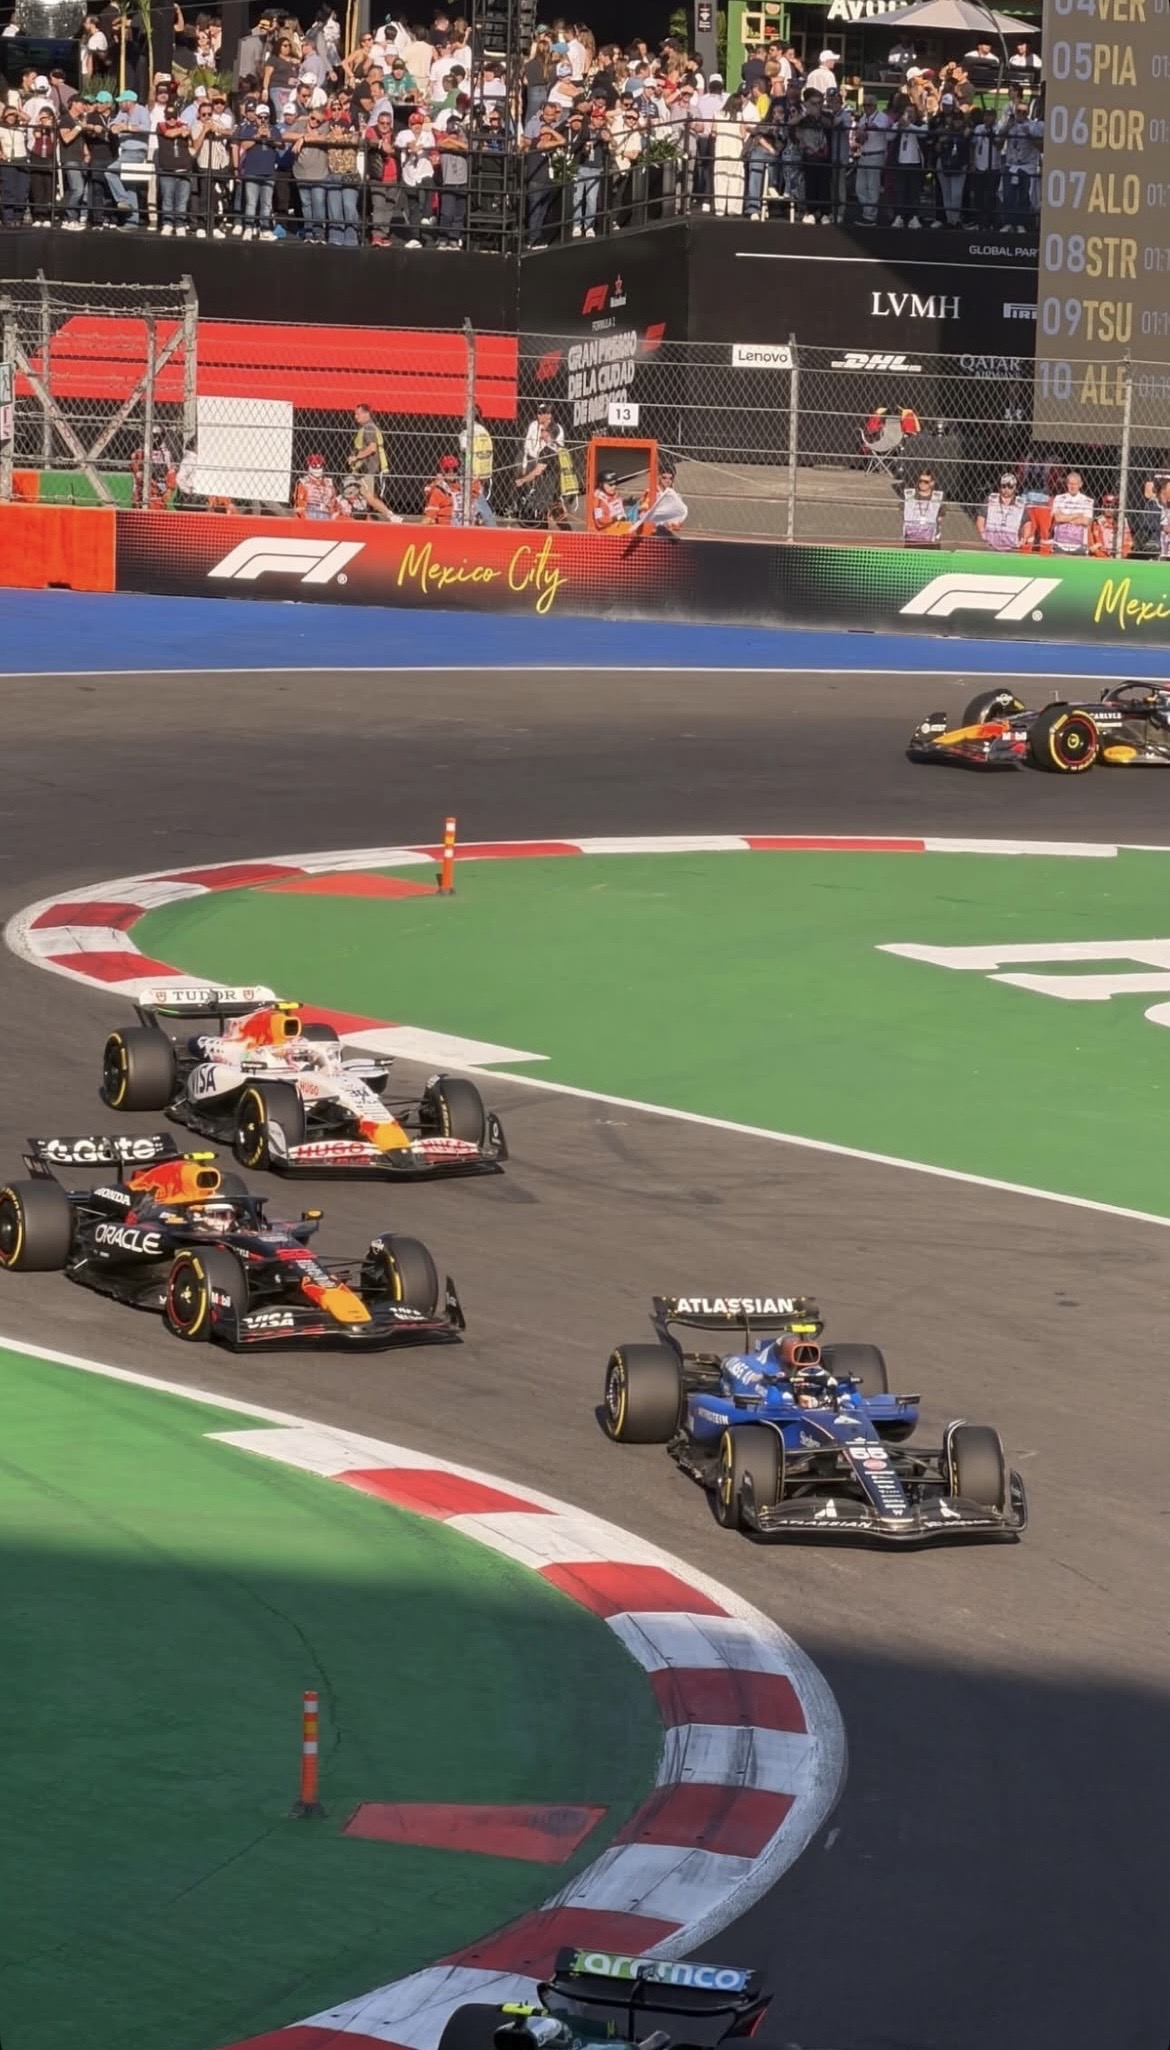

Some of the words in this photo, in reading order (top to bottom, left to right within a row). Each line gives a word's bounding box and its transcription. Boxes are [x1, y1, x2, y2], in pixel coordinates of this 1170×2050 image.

[1052, 41, 1092, 80] 05
[1093, 43, 1137, 86] PIA
[1050, 105, 1088, 144] 06
[1091, 108, 1145, 151] BOR
[1047, 169, 1087, 209] 07
[1087, 172, 1140, 215] ALO
[968, 244, 1013, 257] GLOBAL
[1044, 233, 1085, 273] 08
[1086, 236, 1137, 279] STR
[870, 291, 961, 319] LVMH
[1042, 297, 1081, 336] 09
[1082, 300, 1133, 343] TSU
[567, 340, 598, 371] GRAN
[738, 349, 789, 363] Lenovo
[836, 352, 916, 372] DHL
[960, 354, 1021, 372] QATAR
[568, 373, 583, 400] DE
[583, 369, 597, 396] LA
[1040, 361, 1072, 400] 10
[573, 402, 588, 426] DE
[616, 408, 631, 420] 13
[207, 536, 362, 584] F1
[397, 541, 502, 594] Mexico
[508, 535, 568, 614] City
[899, 573, 1064, 621] F1
[94, 1187, 131, 1207] HONDA
[95, 1223, 163, 1255] ORACLE
[241, 1312, 295, 1329] VISA
[677, 1298, 795, 1314] ATLASSIAN
